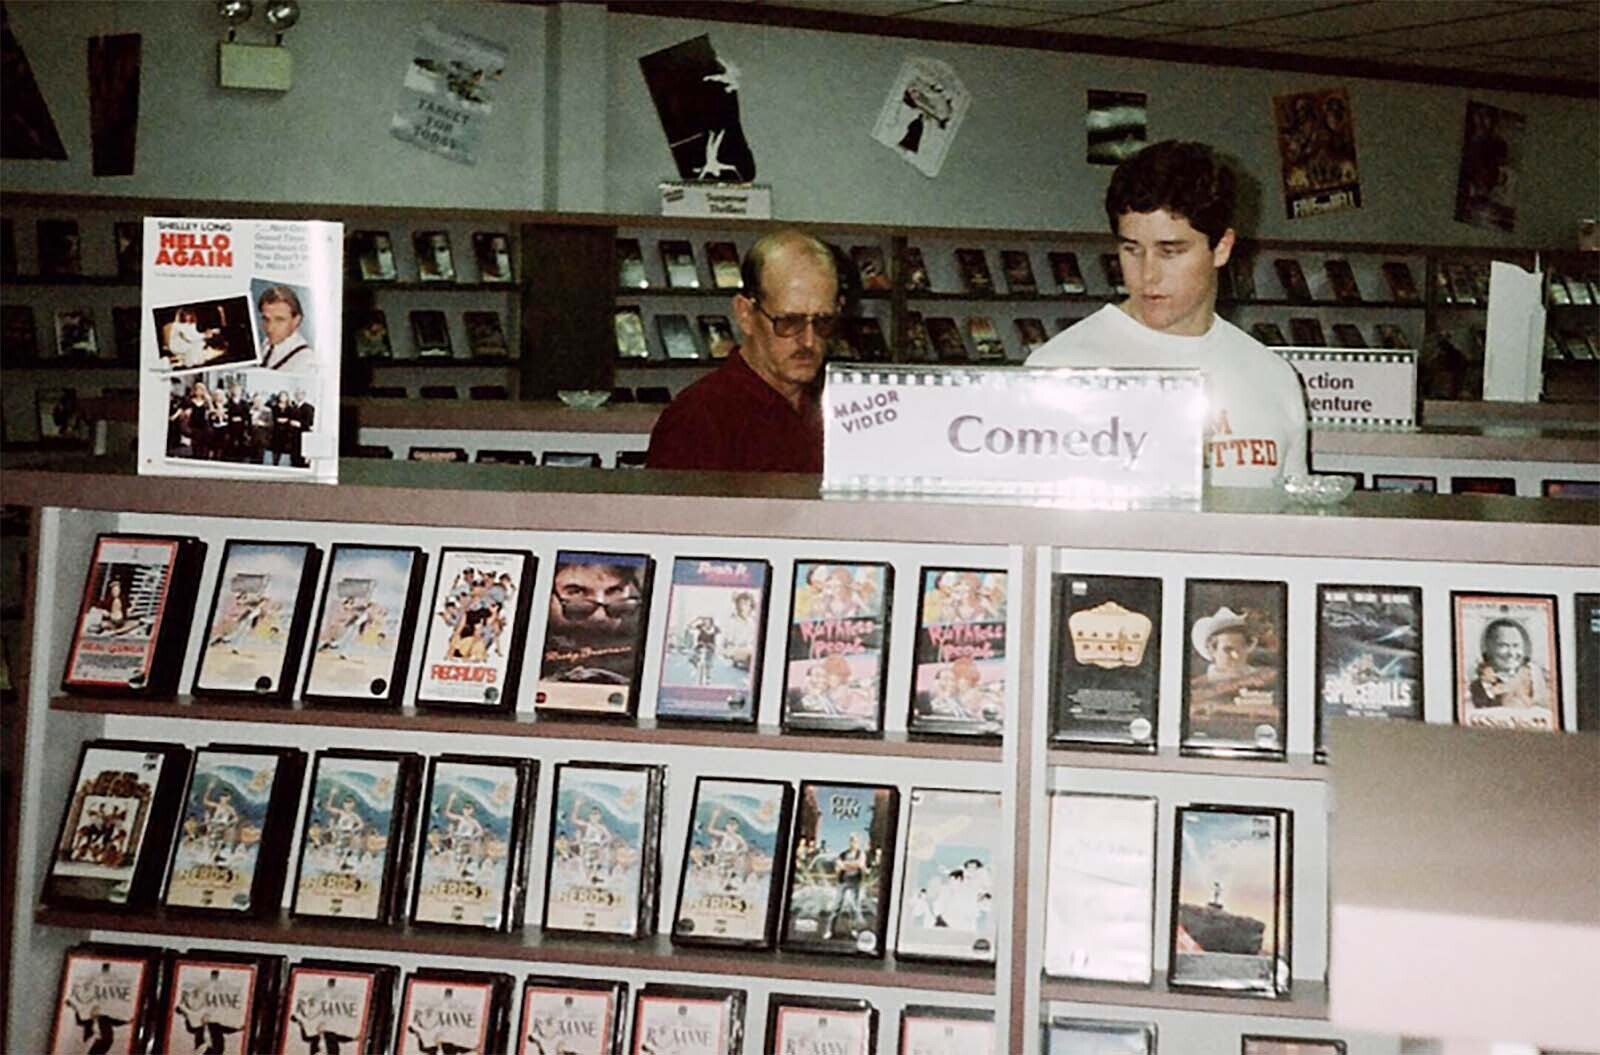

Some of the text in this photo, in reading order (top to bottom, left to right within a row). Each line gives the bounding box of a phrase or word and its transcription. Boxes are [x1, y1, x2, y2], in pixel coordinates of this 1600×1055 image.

[418, 98, 470, 125] TARGET
[157, 221, 232, 232] SHELLEY LONG
[160, 232, 231, 250] HELLO
[155, 250, 233, 268] AGAIN
[1307, 372, 1355, 390] ction
[833, 388, 899, 419] MAJOR
[1310, 396, 1373, 413] enture
[840, 408, 898, 434] VIDEO
[947, 414, 1149, 471] Comedy
